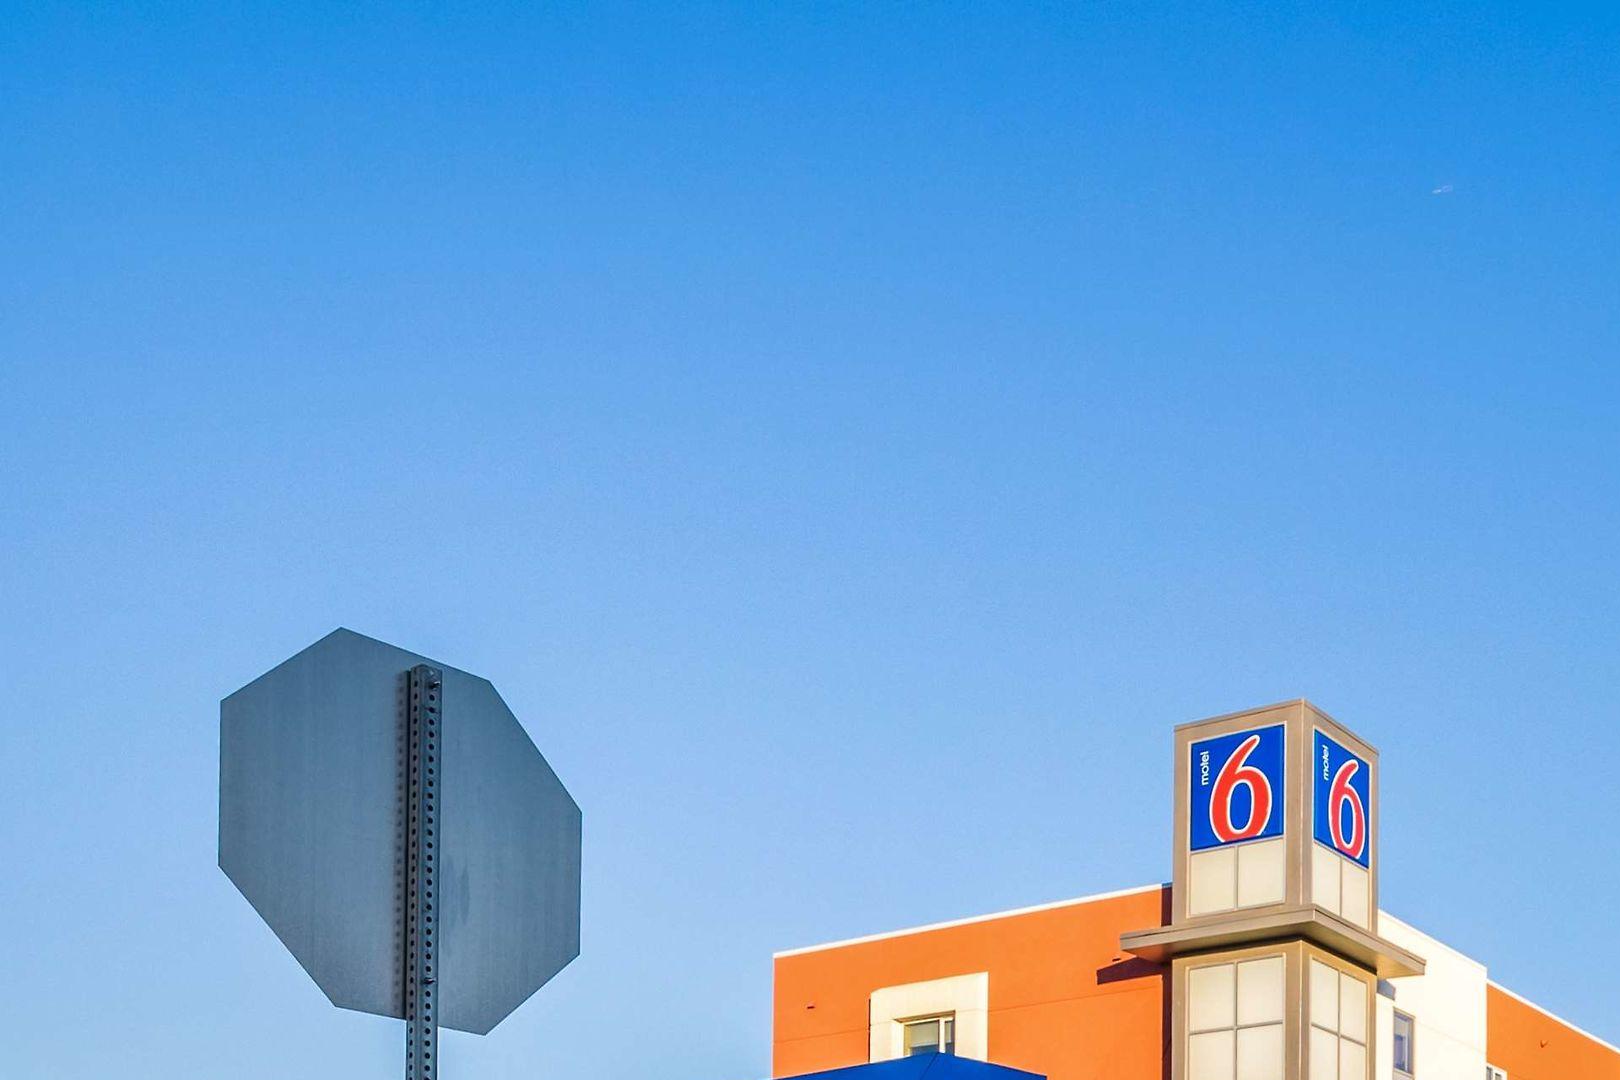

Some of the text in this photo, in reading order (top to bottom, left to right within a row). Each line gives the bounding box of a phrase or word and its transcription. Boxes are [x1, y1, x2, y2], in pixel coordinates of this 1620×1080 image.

[1199, 750, 1210, 786] motel
[1209, 734, 1273, 843] 6
[1321, 743, 1330, 781] motel
[1328, 759, 1366, 859] 6
